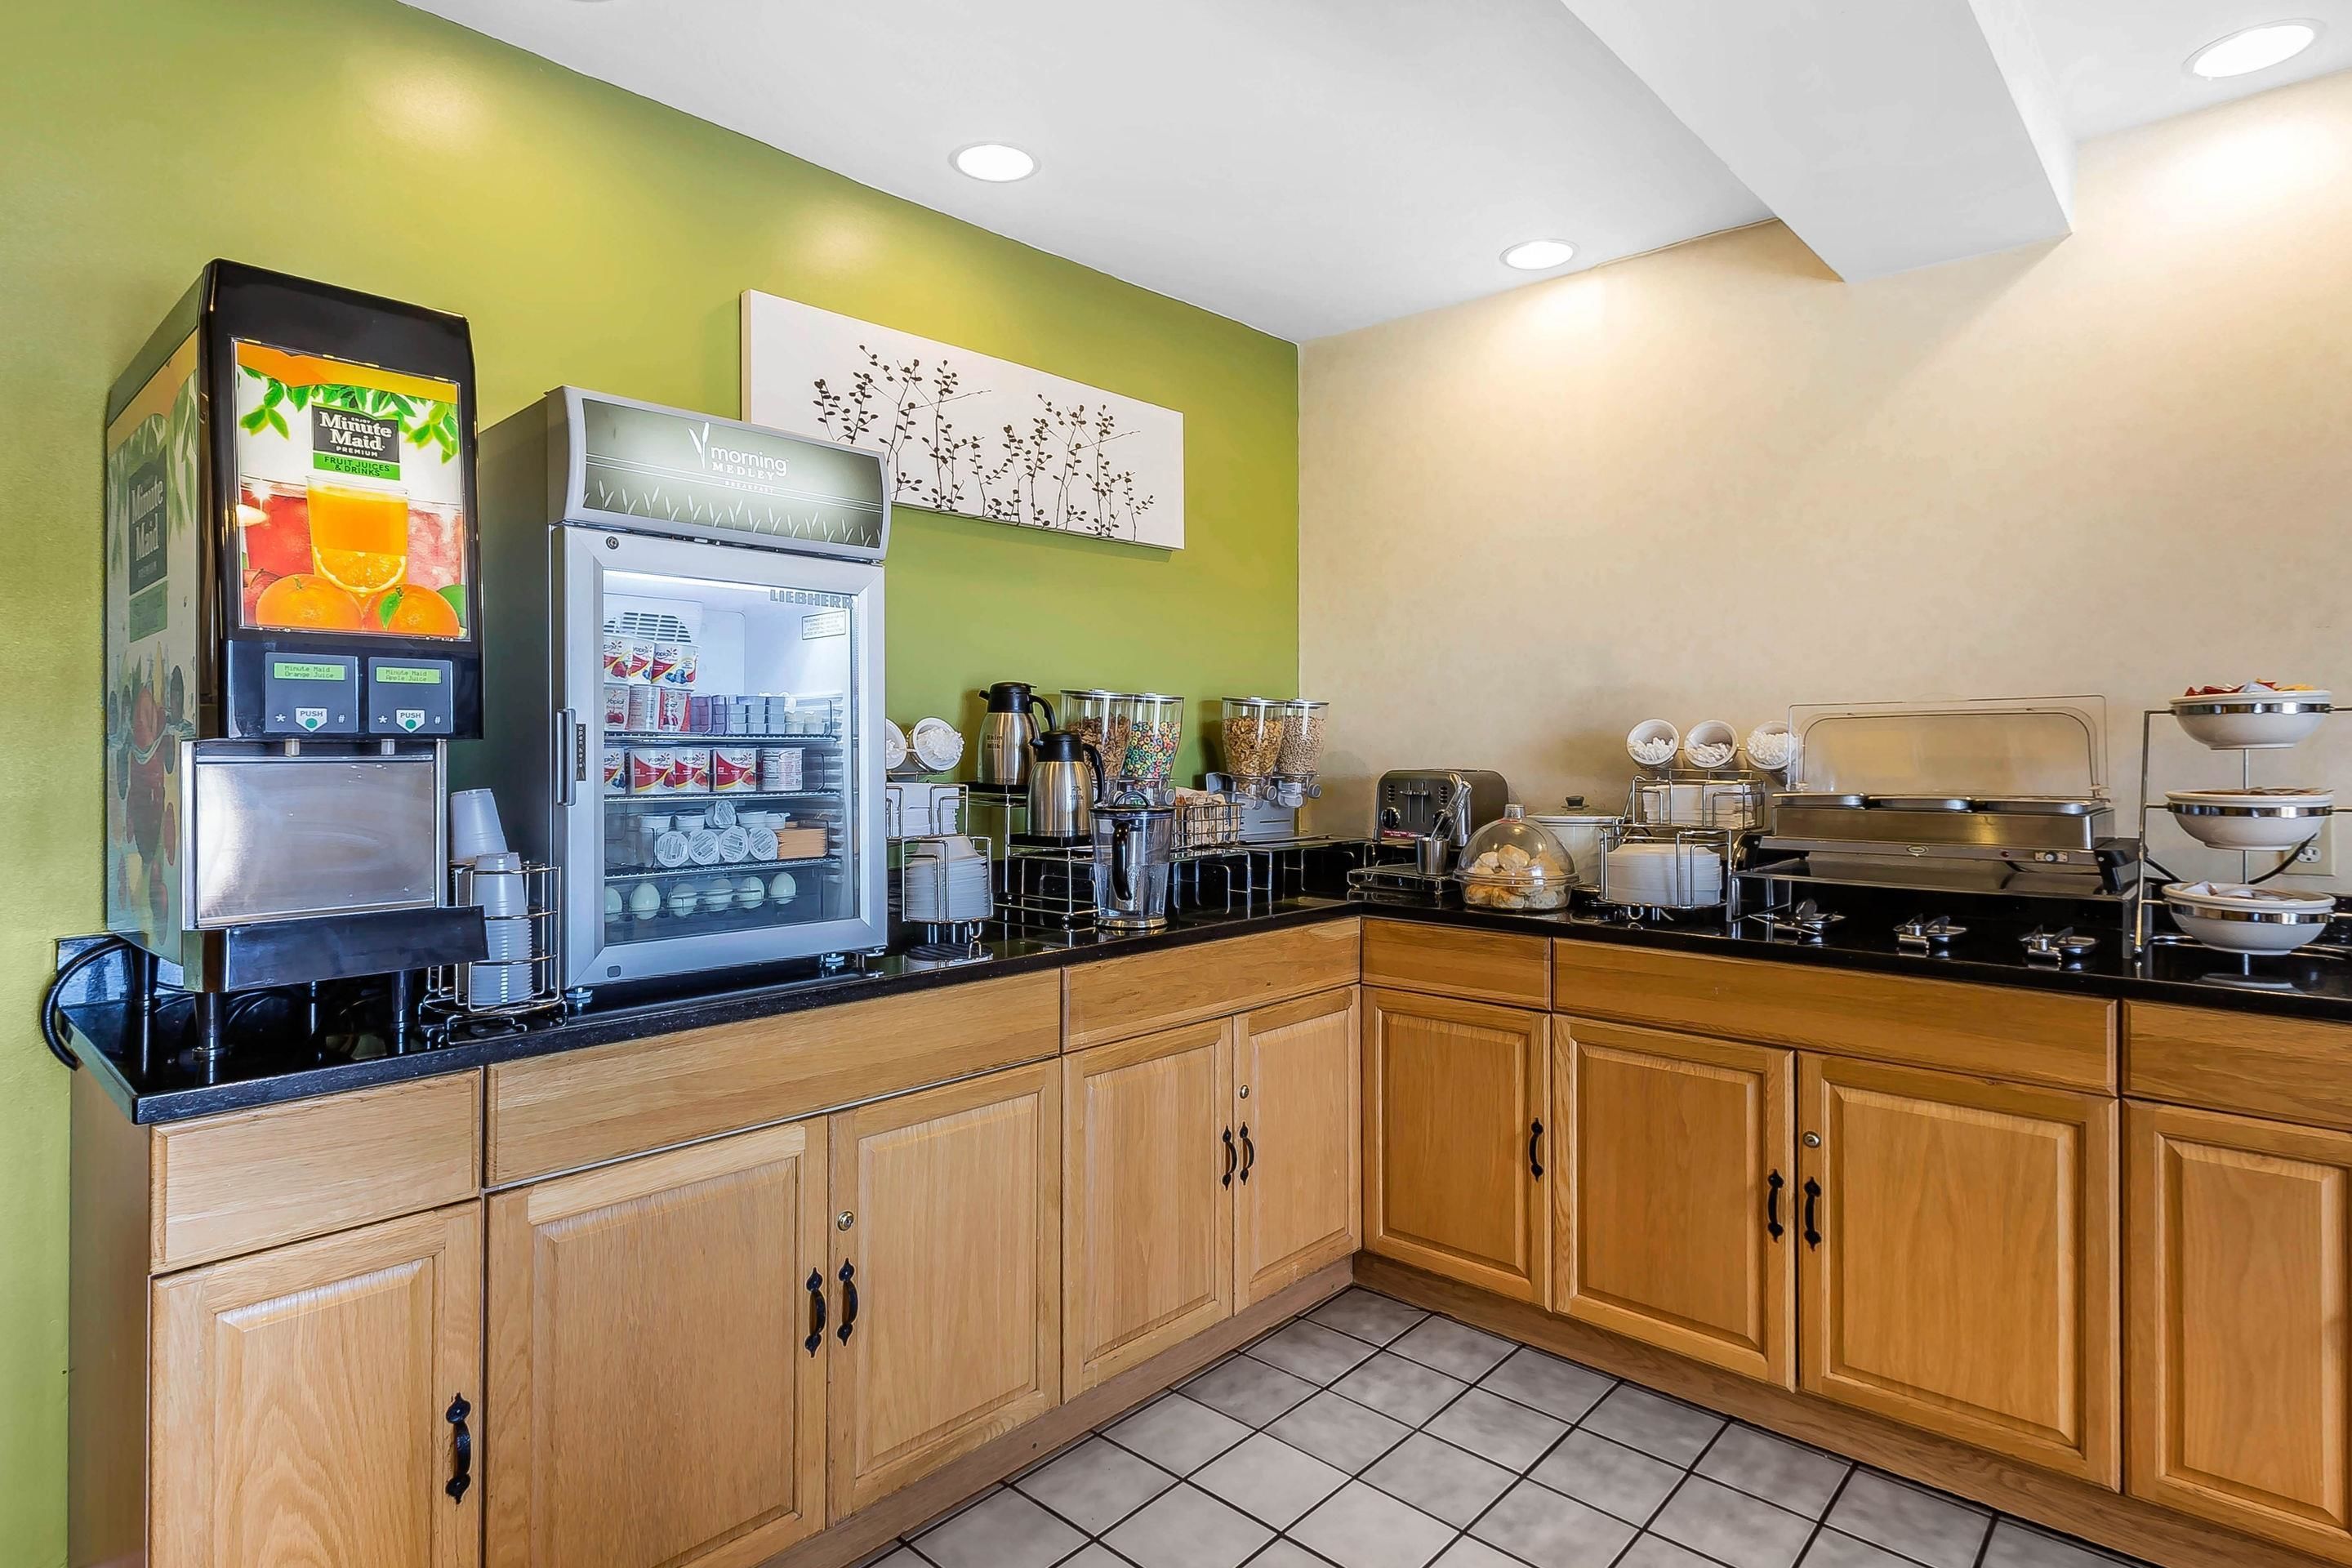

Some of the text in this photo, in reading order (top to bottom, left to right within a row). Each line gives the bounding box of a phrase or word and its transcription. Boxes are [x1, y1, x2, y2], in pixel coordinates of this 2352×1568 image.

[318, 411, 392, 438] Minute
[329, 428, 384, 451] Maid
[336, 446, 378, 457] PREMIUM
[710, 446, 787, 477] morning
[324, 456, 390, 472] FRUIT JUICES
[345, 466, 381, 477] DRINKS
[712, 461, 775, 481] MEDLEY
[131, 474, 163, 524] Minute
[136, 512, 159, 562] Maid
[769, 589, 853, 610] LIEBHERR
